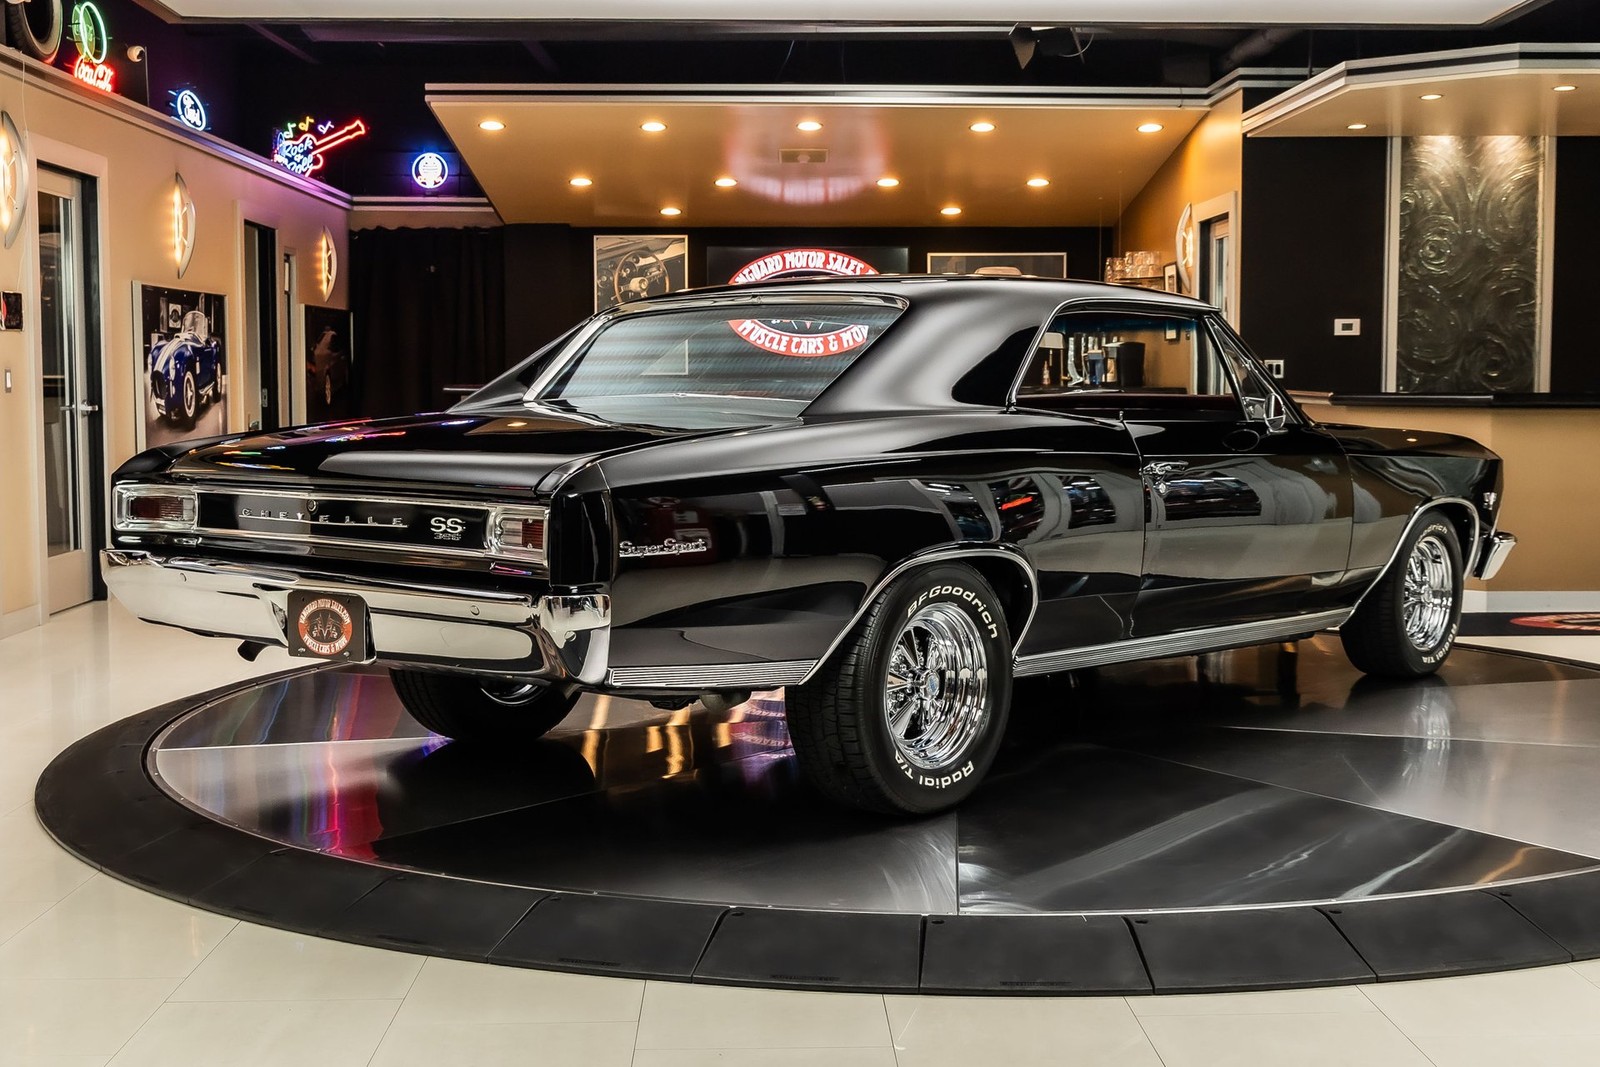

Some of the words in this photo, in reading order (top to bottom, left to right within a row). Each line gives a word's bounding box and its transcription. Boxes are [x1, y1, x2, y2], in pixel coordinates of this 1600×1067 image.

[784, 251, 825, 268] MOTOR
[737, 319, 790, 352] MUSCLE
[790, 336, 825, 354] CARS
[827, 334, 839, 352] &
[241, 508, 404, 526] CHEVELLE
[430, 516, 463, 534] SS
[907, 586, 998, 639] BFGoodrich
[895, 749, 914, 780] T/A
[918, 760, 975, 789] Radial
